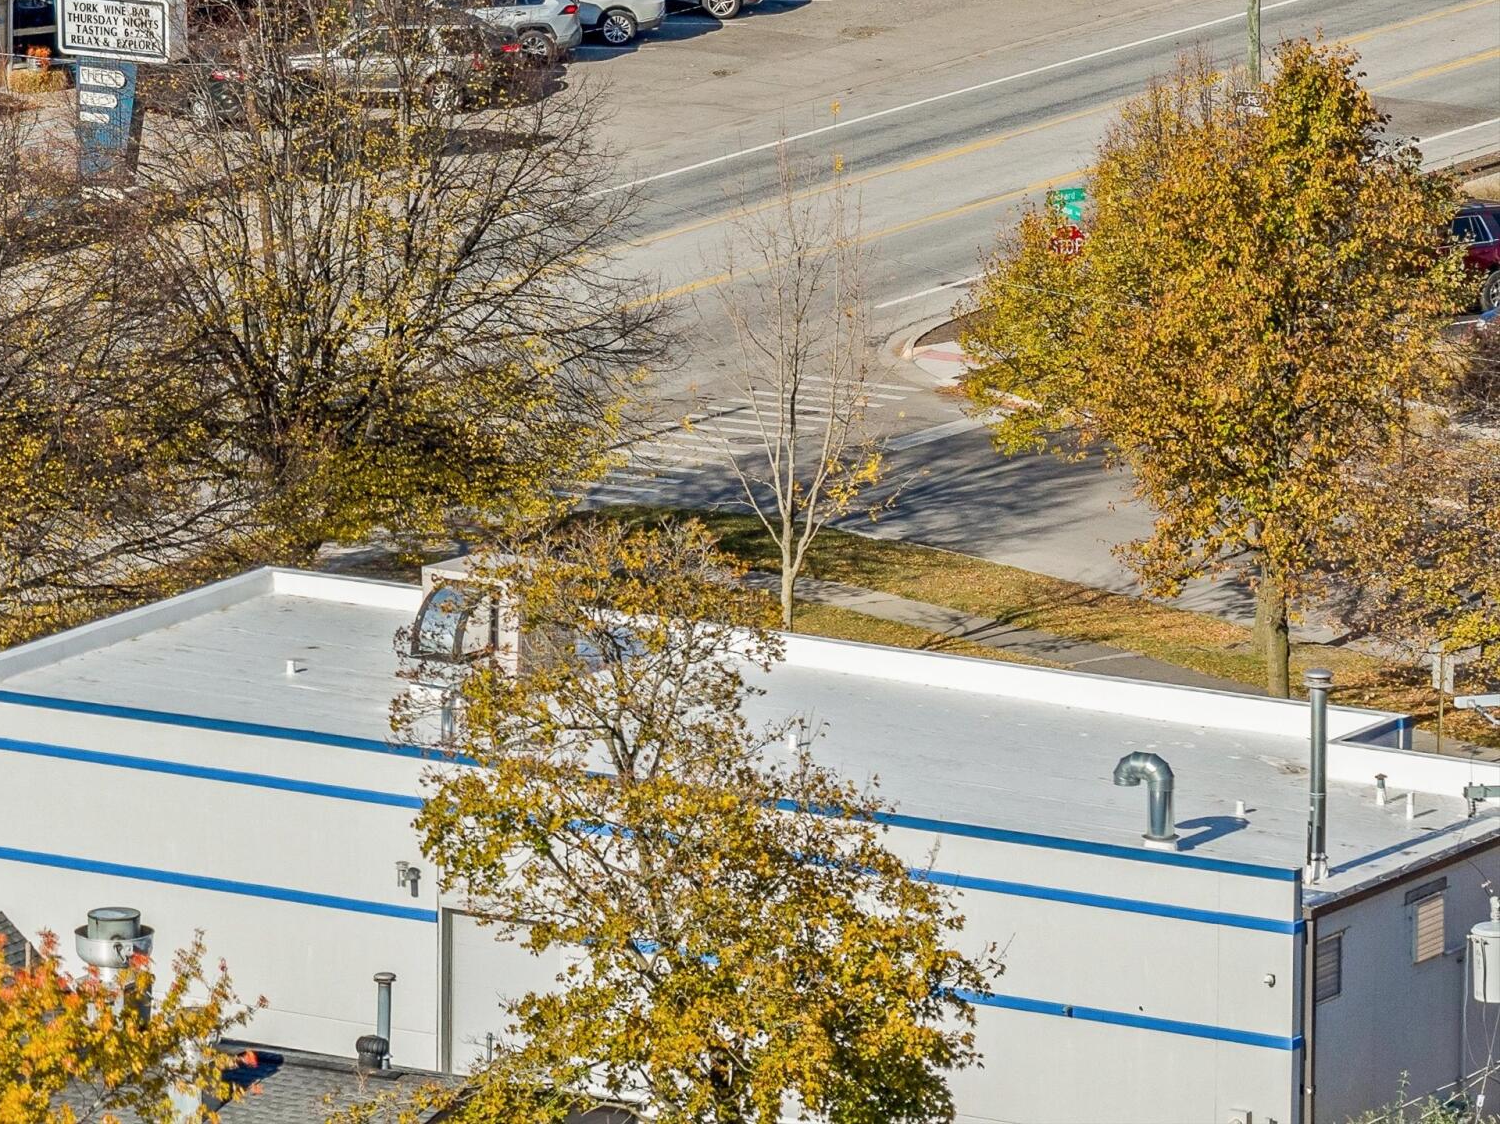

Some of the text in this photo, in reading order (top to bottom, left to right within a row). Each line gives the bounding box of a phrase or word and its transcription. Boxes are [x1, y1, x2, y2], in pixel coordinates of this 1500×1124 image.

[73, 2, 150, 18] YORK WINE BAR
[67, 12, 159, 29] THURSDAY NIGHTS
[75, 24, 118, 36] TASTING
[71, 34, 156, 51] RELAX & EXPLORE
